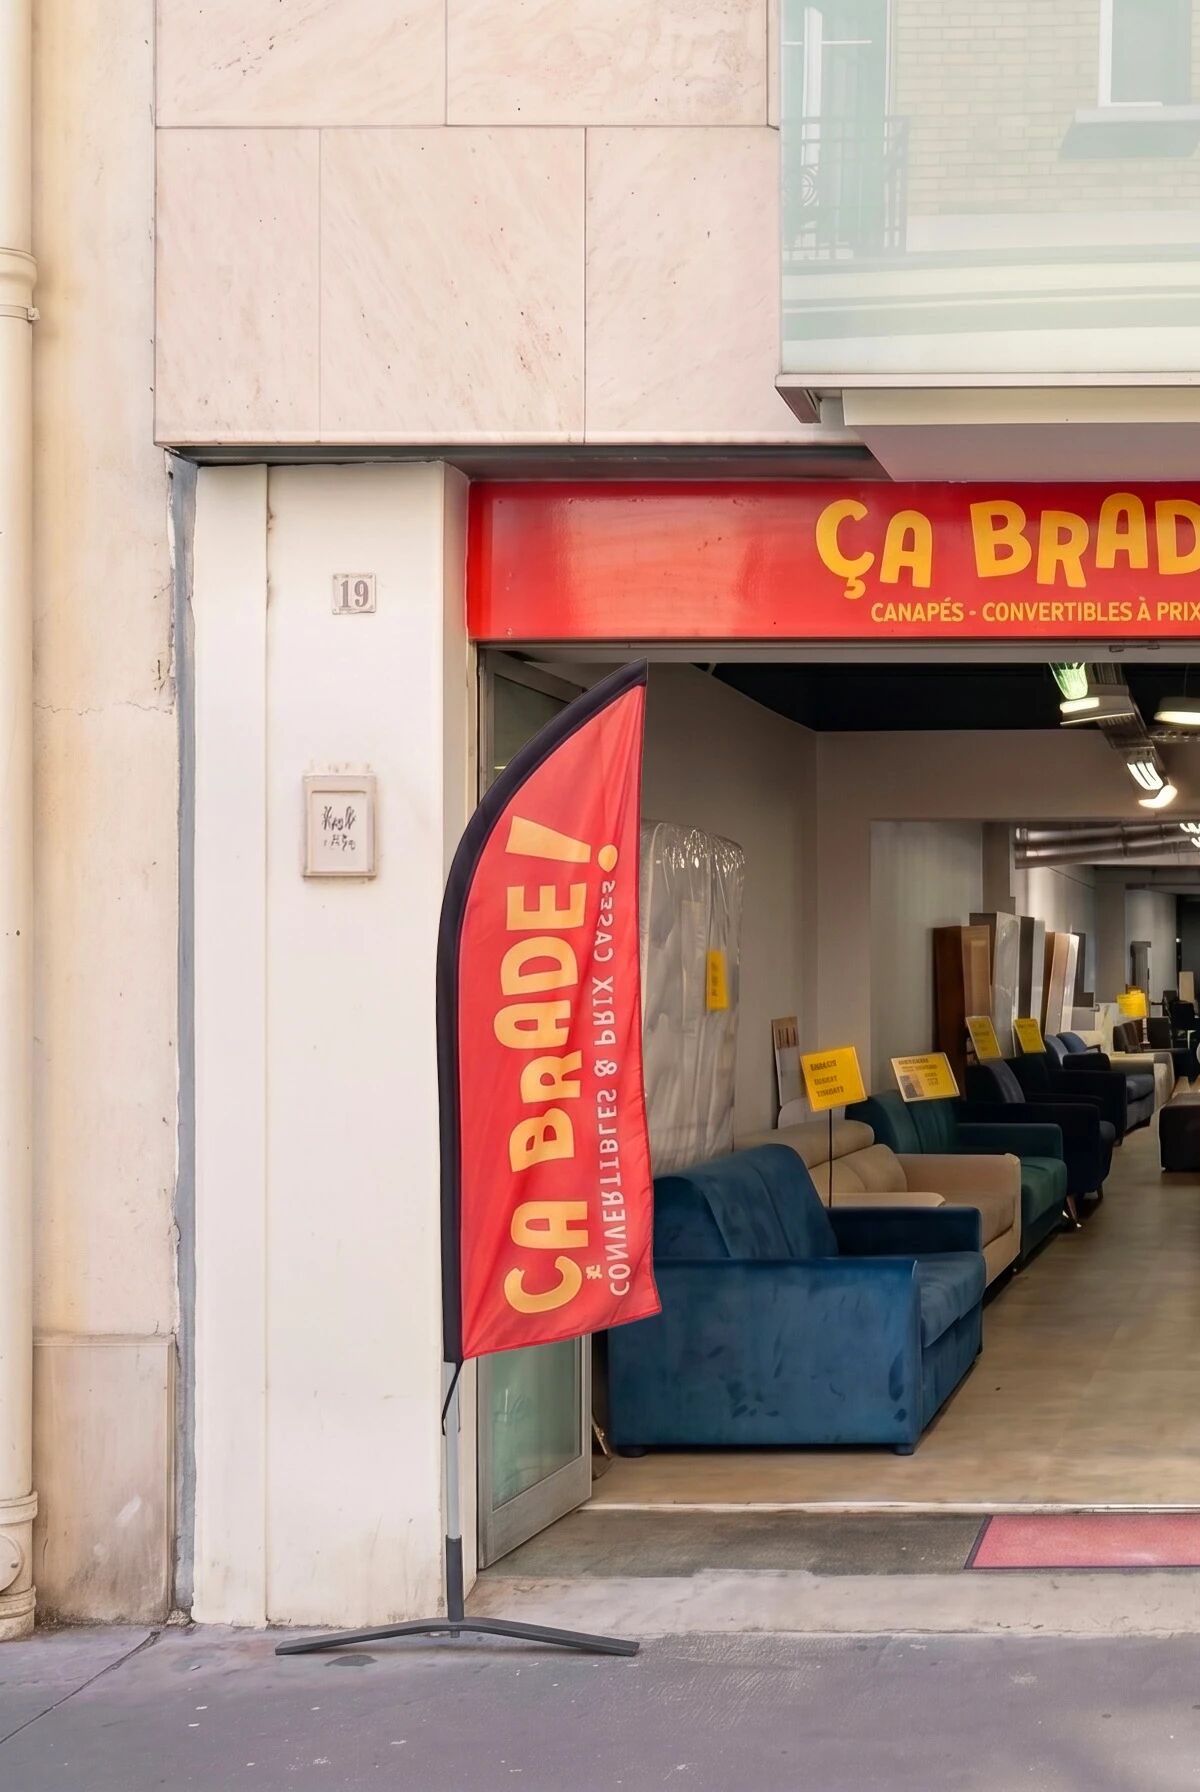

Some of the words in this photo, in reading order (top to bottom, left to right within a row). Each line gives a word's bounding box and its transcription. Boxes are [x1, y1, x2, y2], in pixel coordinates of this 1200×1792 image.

[815, 498, 933, 600] ÇA
[339, 579, 370, 609] 19
[870, 597, 965, 623] CANAPÉS
[982, 601, 1133, 623] CONVERTIBLES
[1136, 596, 1151, 622] À
